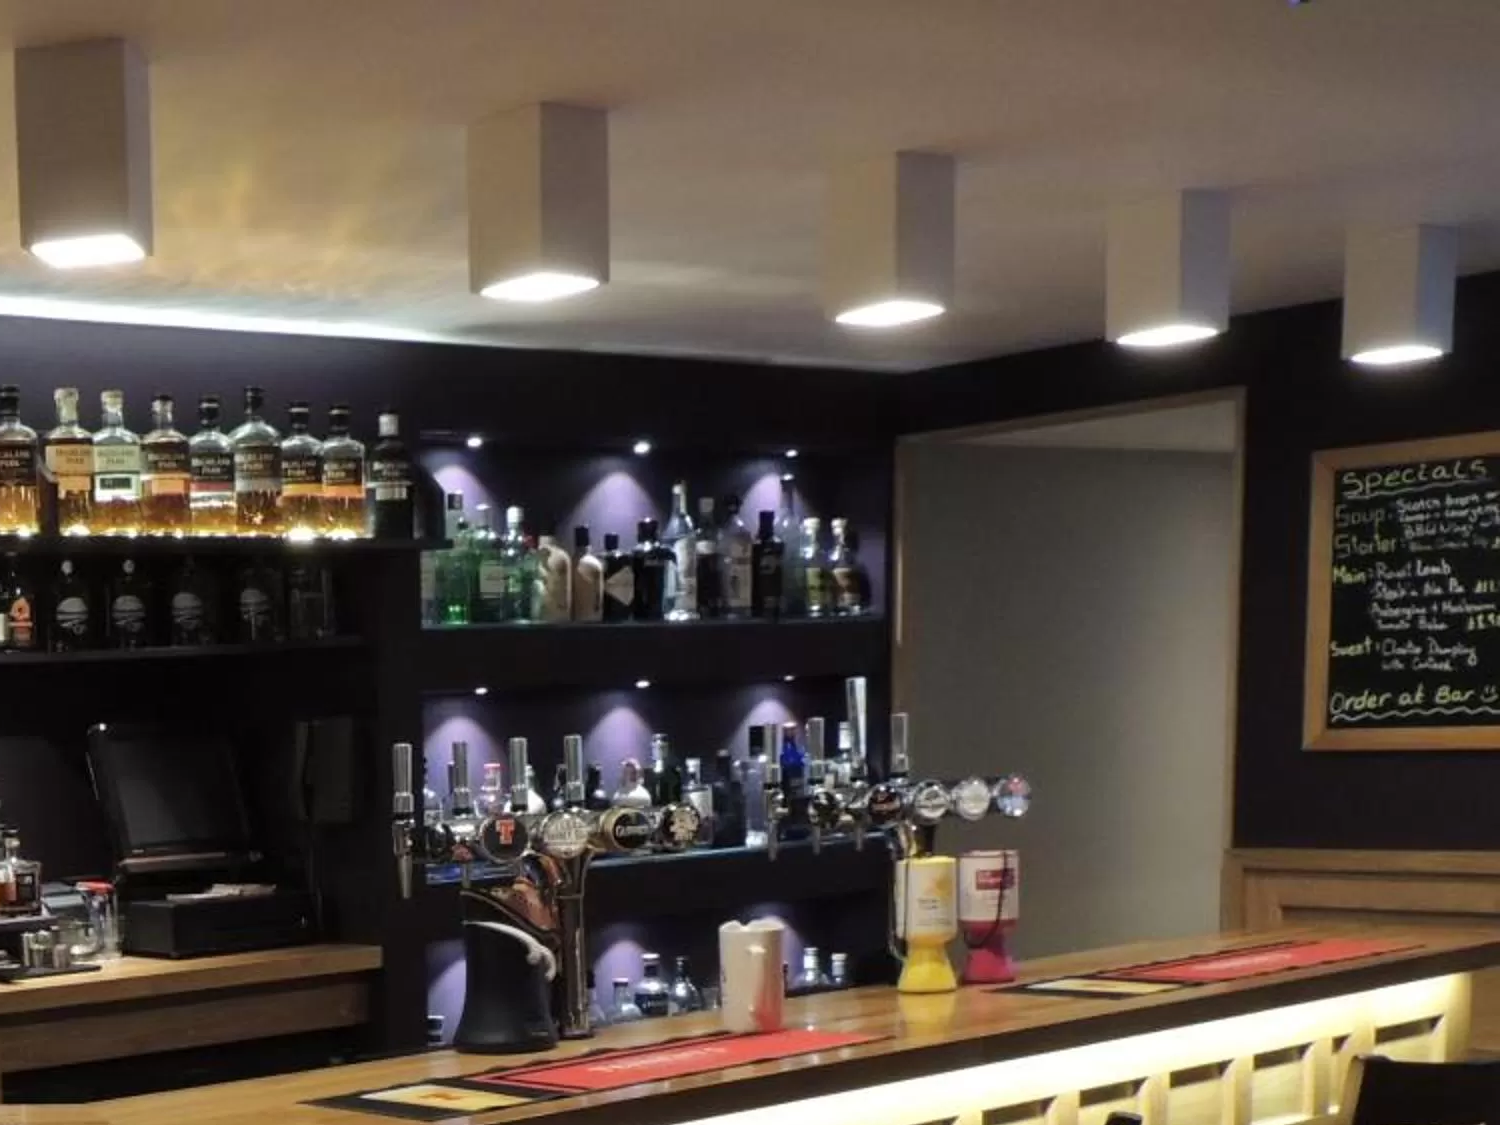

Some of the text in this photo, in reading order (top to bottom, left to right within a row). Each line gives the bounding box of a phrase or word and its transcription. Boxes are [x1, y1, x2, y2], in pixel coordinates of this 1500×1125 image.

[1343, 460, 1487, 494] Specials
[1329, 681, 1476, 714] Order at Bar
